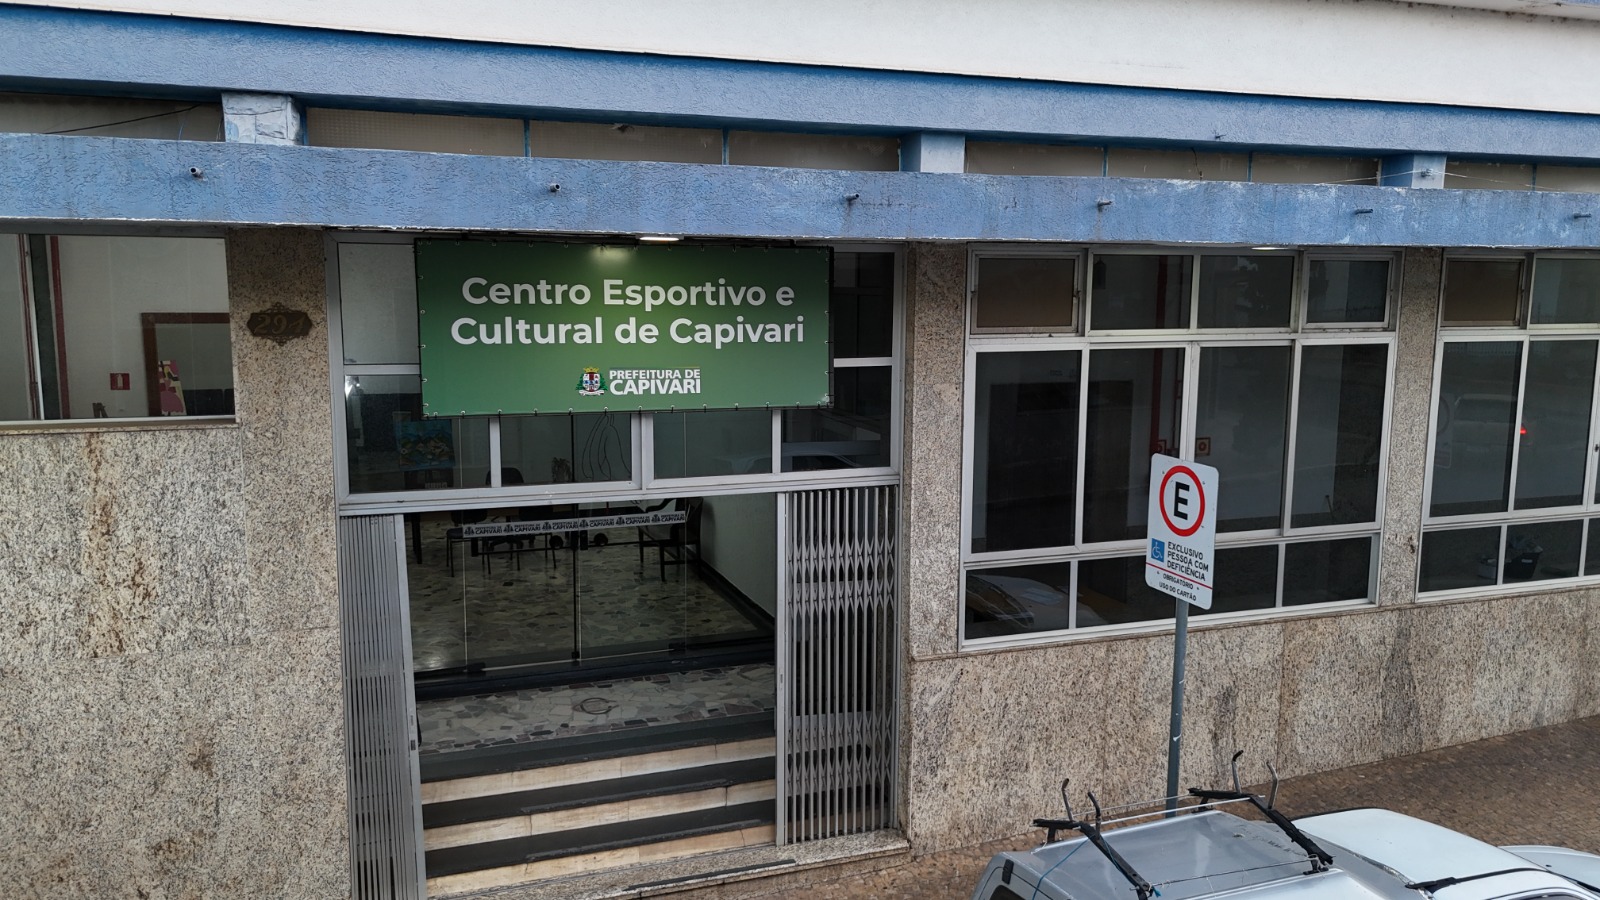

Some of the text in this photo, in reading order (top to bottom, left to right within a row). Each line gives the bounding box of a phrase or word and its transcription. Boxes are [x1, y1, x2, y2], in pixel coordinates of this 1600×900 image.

[462, 277, 795, 312] Centro Esportivo e
[451, 315, 804, 350] Cultural de Capivari
[609, 369, 701, 380] PREFEITURA DE
[609, 379, 701, 395] CAPIVARI
[1174, 481, 1190, 521] E
[1167, 541, 1204, 560] EXCLUSIVO
[1167, 550, 1209, 573] PESSOA COM
